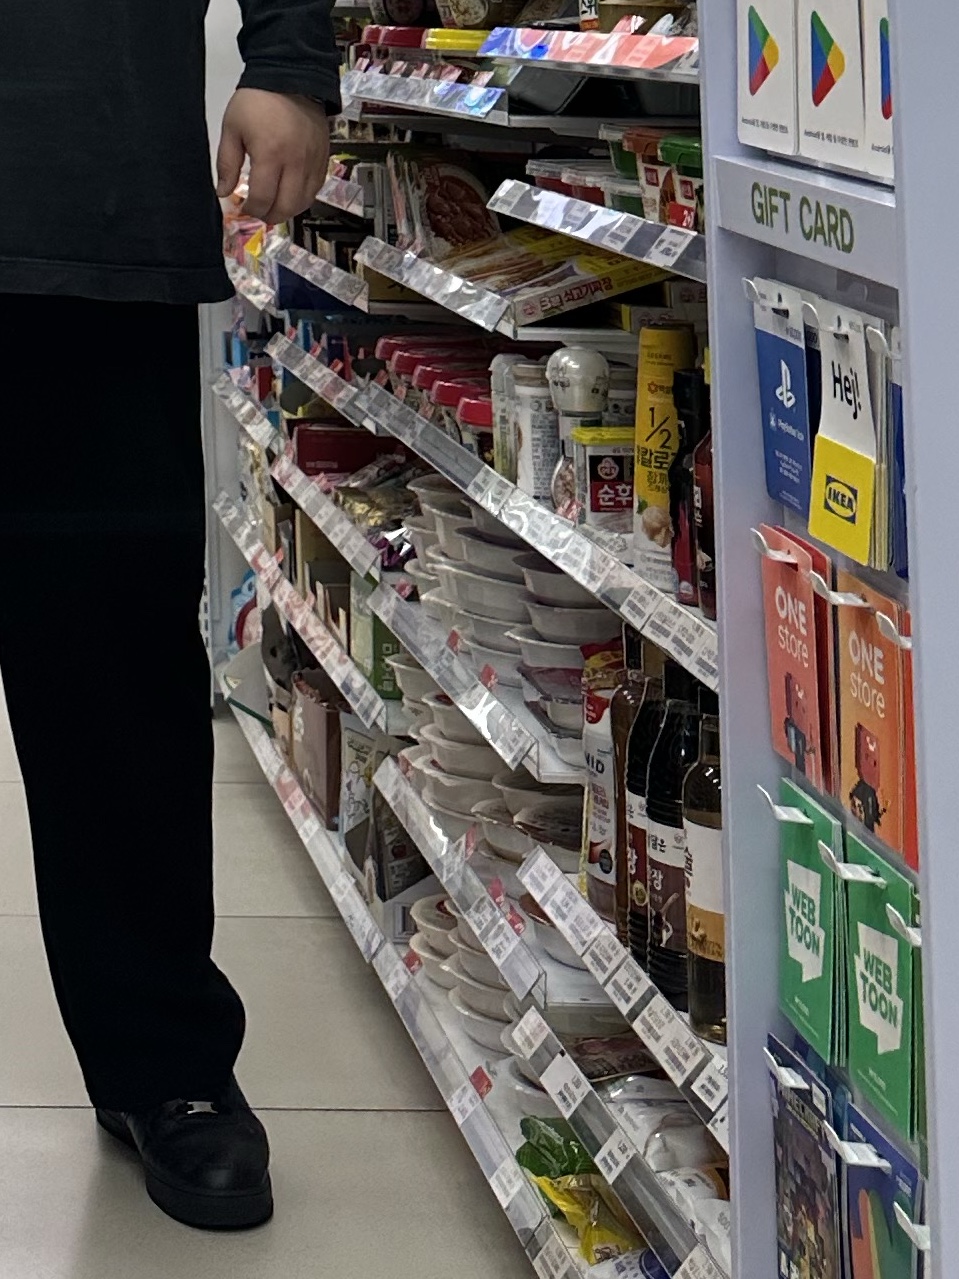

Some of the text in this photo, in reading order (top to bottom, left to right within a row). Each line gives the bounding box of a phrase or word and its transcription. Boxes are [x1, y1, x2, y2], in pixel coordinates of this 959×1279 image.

[750, 180, 855, 255] GIFT CARD
[831, 360, 862, 421] Hej!
[596, 483, 633, 507] 순후
[826, 485, 855, 514] IKEA
[774, 585, 808, 637] ONE
[777, 623, 809, 669] store
[848, 630, 885, 686] ONE
[849, 674, 885, 720] store
[791, 882, 817, 925] WEB
[788, 905, 821, 959] TOON
[862, 946, 893, 996] WEB
[859, 970, 900, 1030] TOON
